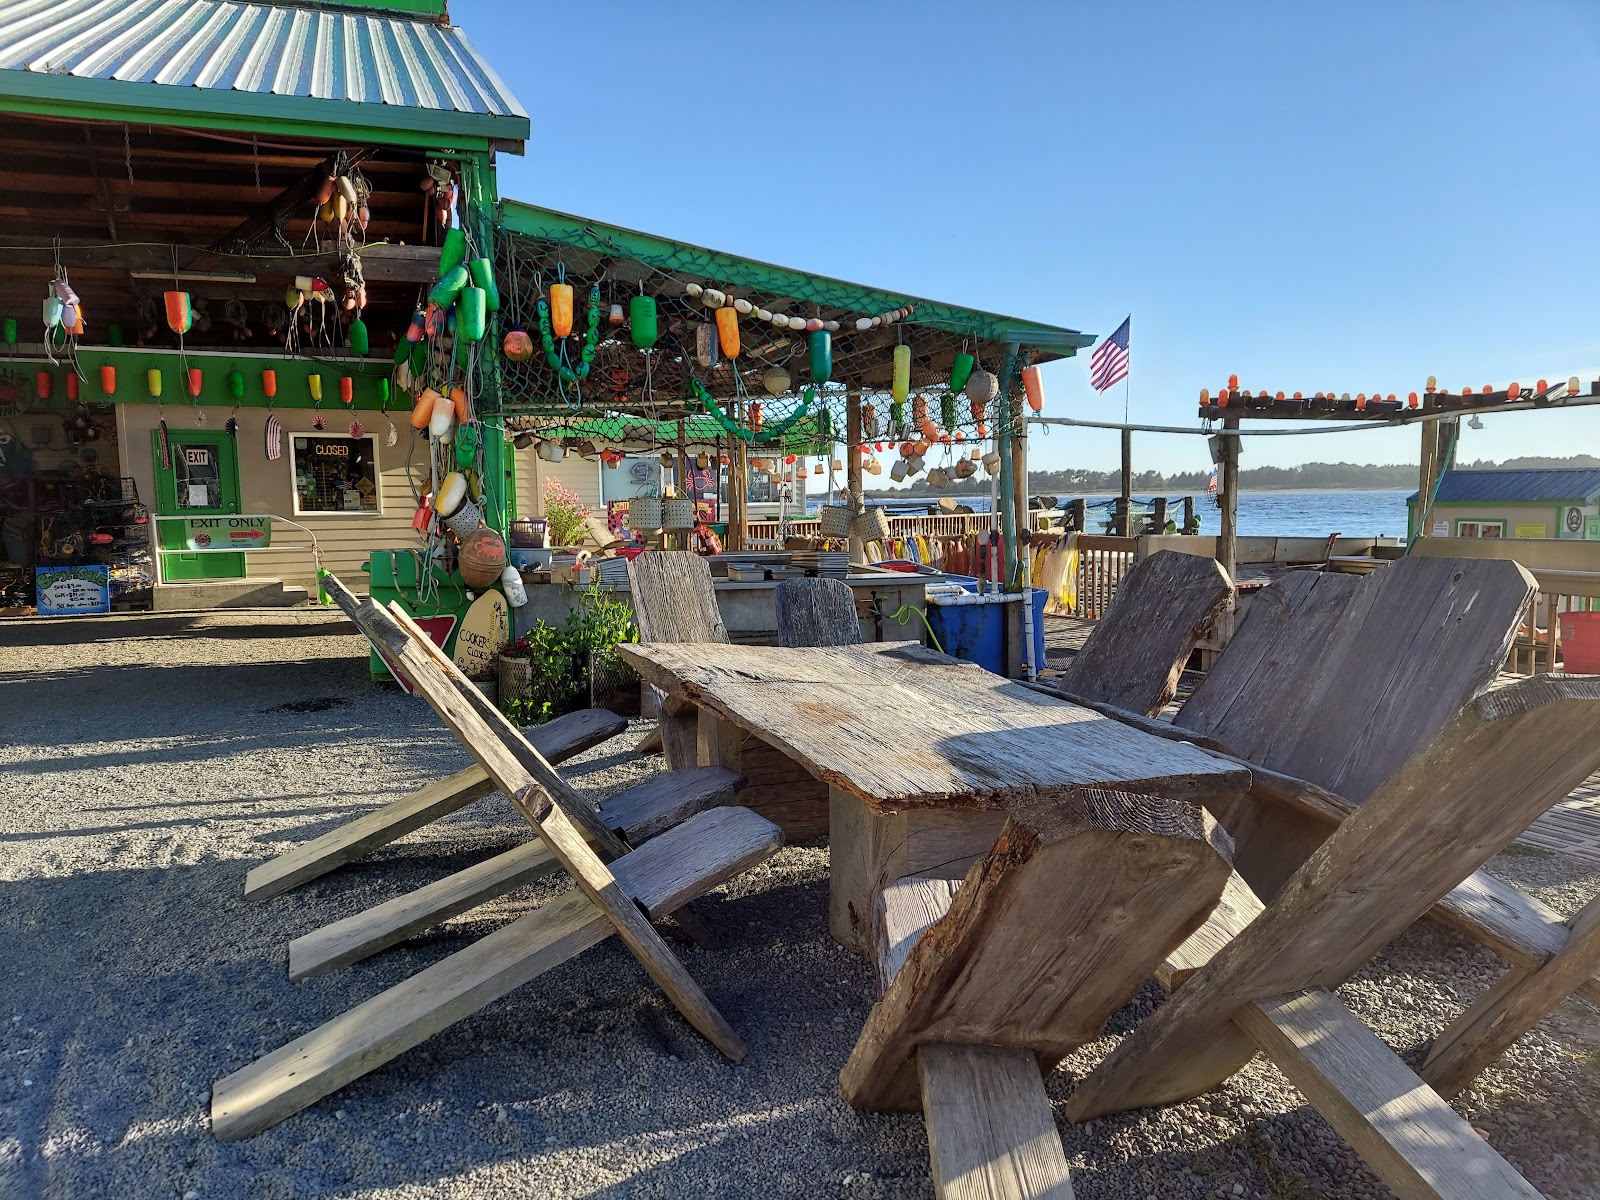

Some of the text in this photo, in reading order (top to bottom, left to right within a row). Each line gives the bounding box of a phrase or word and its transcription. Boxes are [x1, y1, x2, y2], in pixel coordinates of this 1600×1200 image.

[315, 445, 348, 455] CLOSED
[188, 451, 206, 463] EXIT
[190, 518, 266, 528] EXIT ONLY
